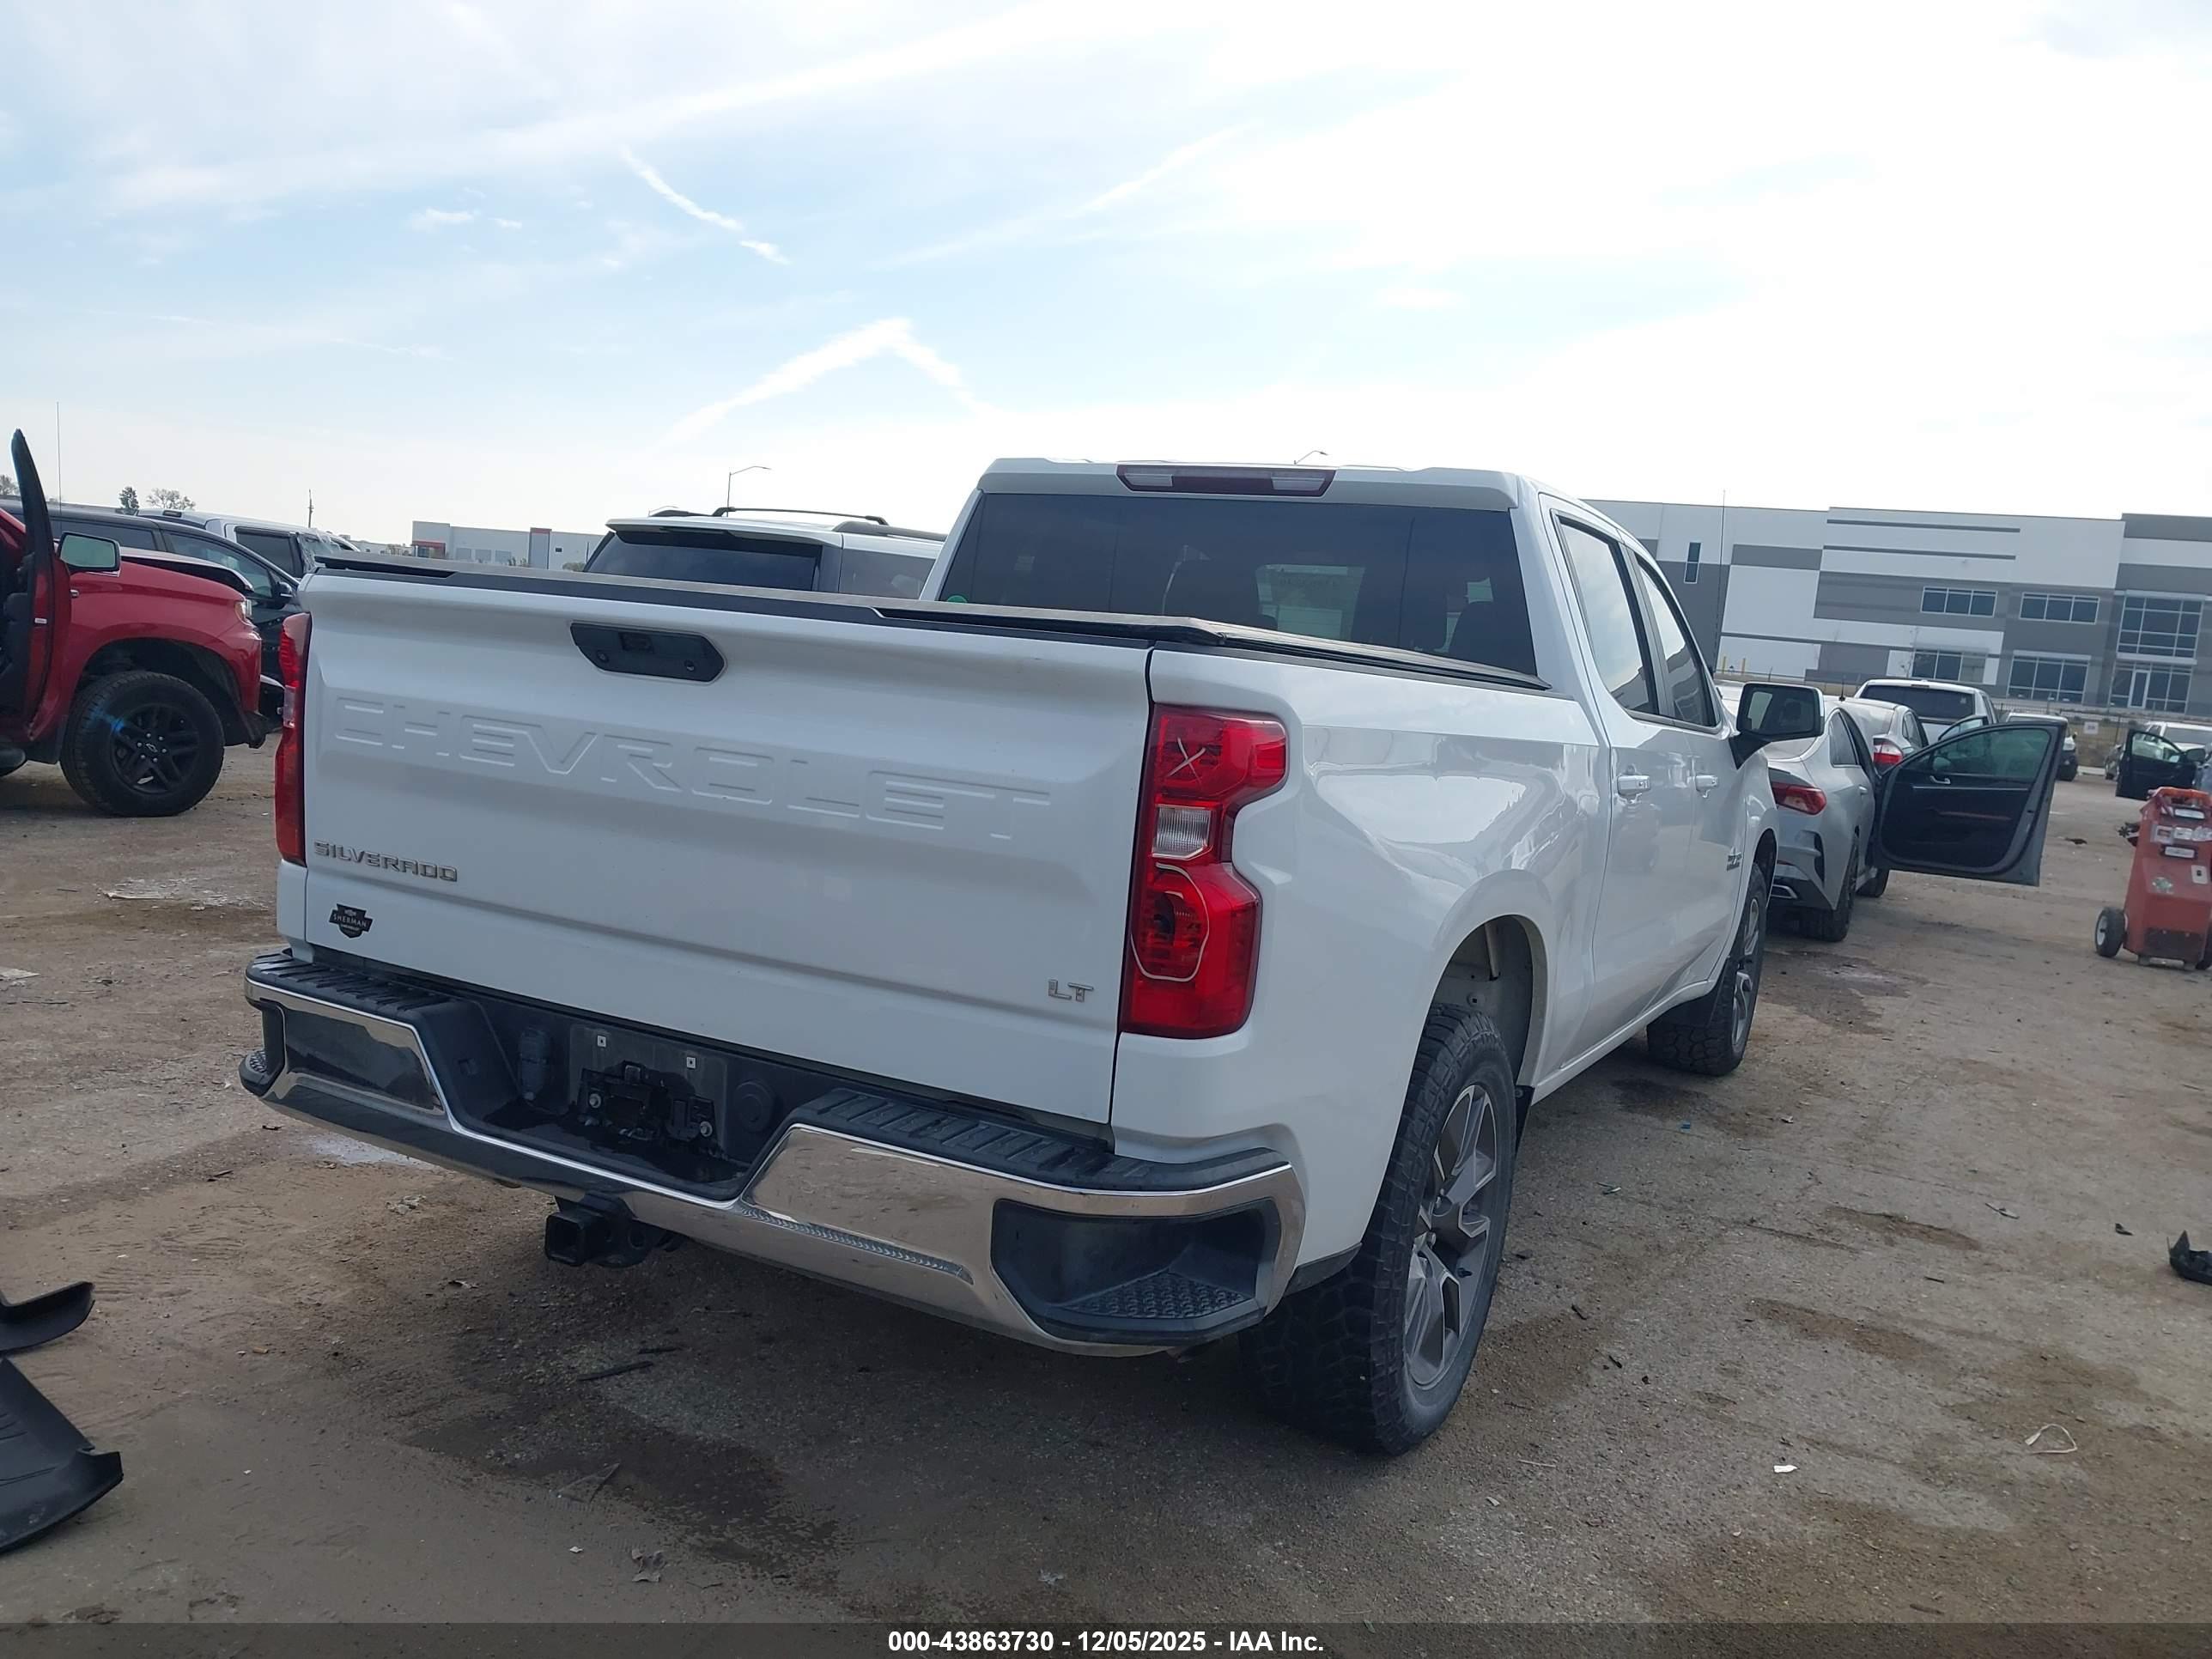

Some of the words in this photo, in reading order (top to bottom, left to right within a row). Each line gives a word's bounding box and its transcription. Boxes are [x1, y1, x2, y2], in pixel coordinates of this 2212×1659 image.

[334, 694, 1052, 841] CHEVROLET
[313, 839, 458, 883] SILVERADO
[1047, 978, 1095, 1003] LT
